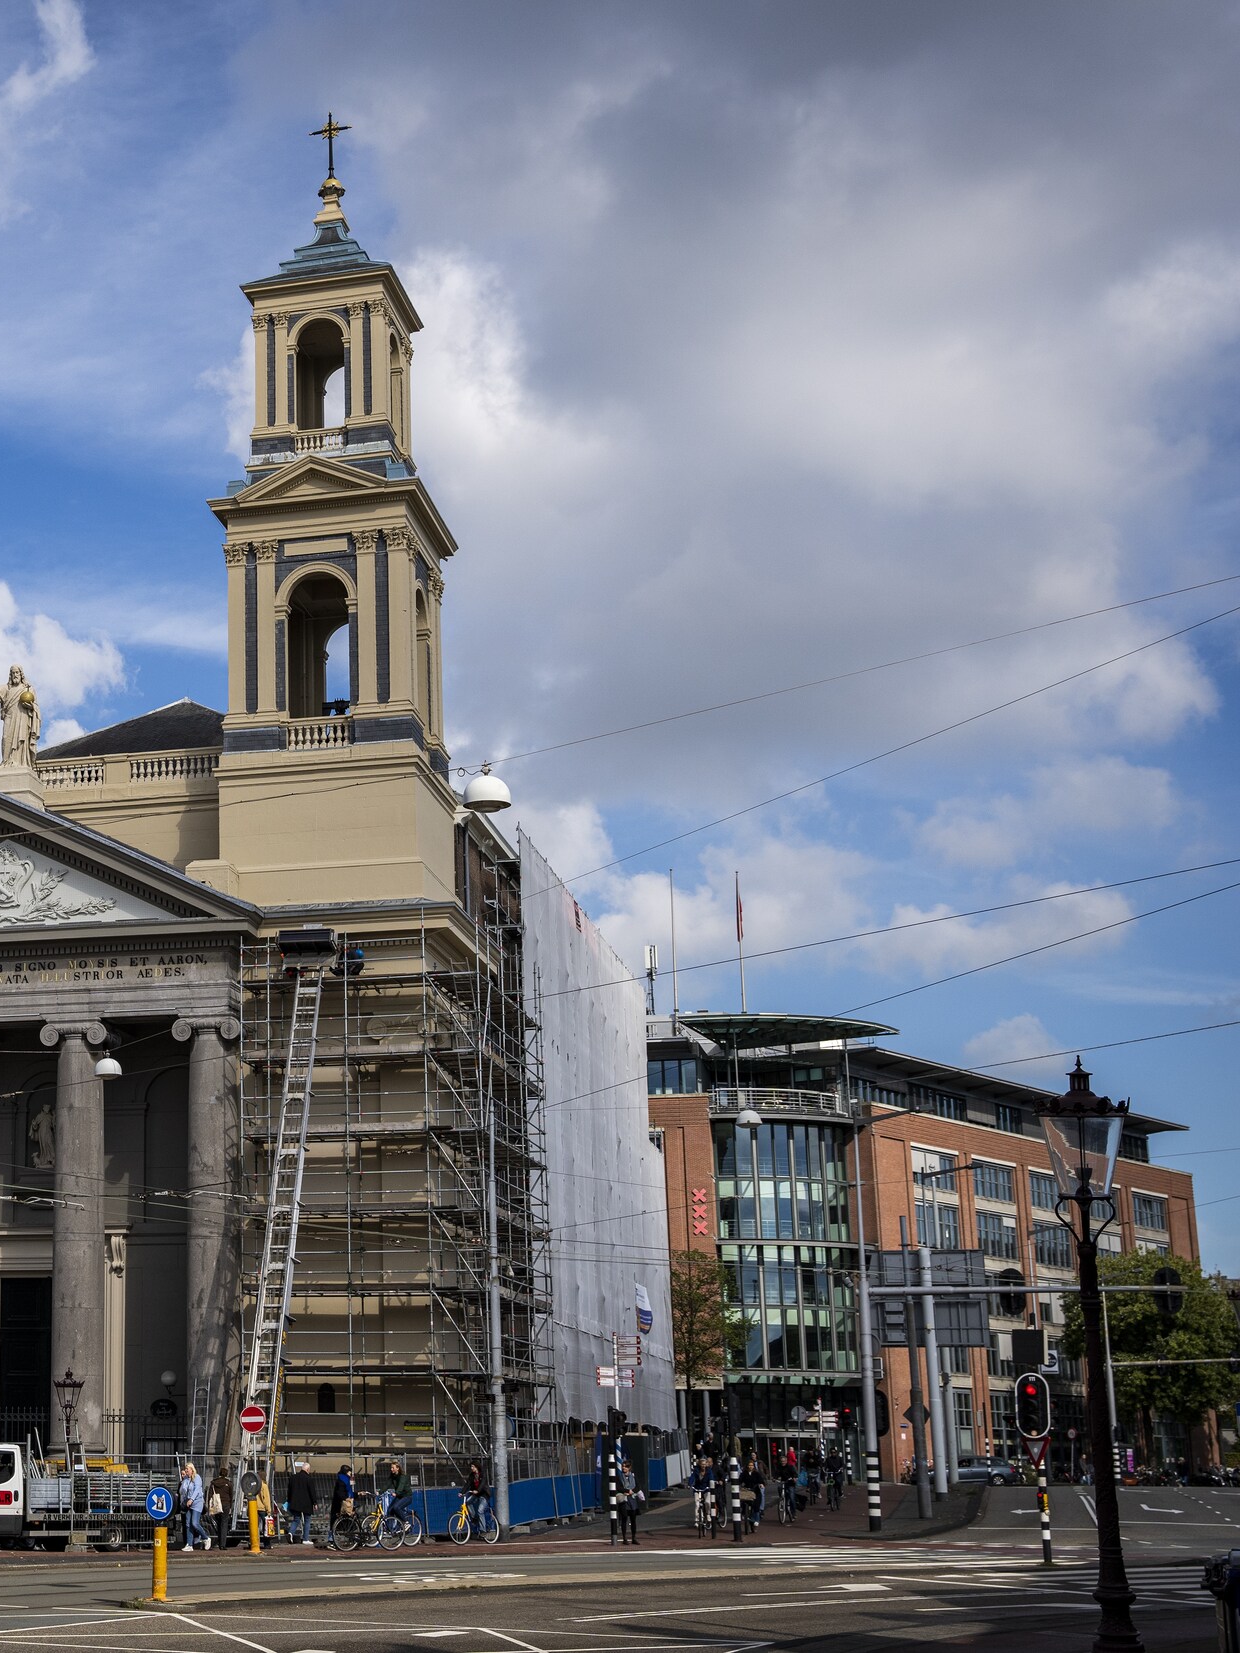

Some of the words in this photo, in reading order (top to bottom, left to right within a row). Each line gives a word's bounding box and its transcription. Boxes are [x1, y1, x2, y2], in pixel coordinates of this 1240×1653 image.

[15, 961, 56, 972] SIGNO
[68, 958, 118, 970] MOYSIS
[130, 957, 149, 967] ET
[158, 954, 208, 966] AARON,
[41, 970, 123, 983] ILLUSTRIOR
[137, 967, 186, 980] AEDES.
[43, 1513, 52, 1521] AR
